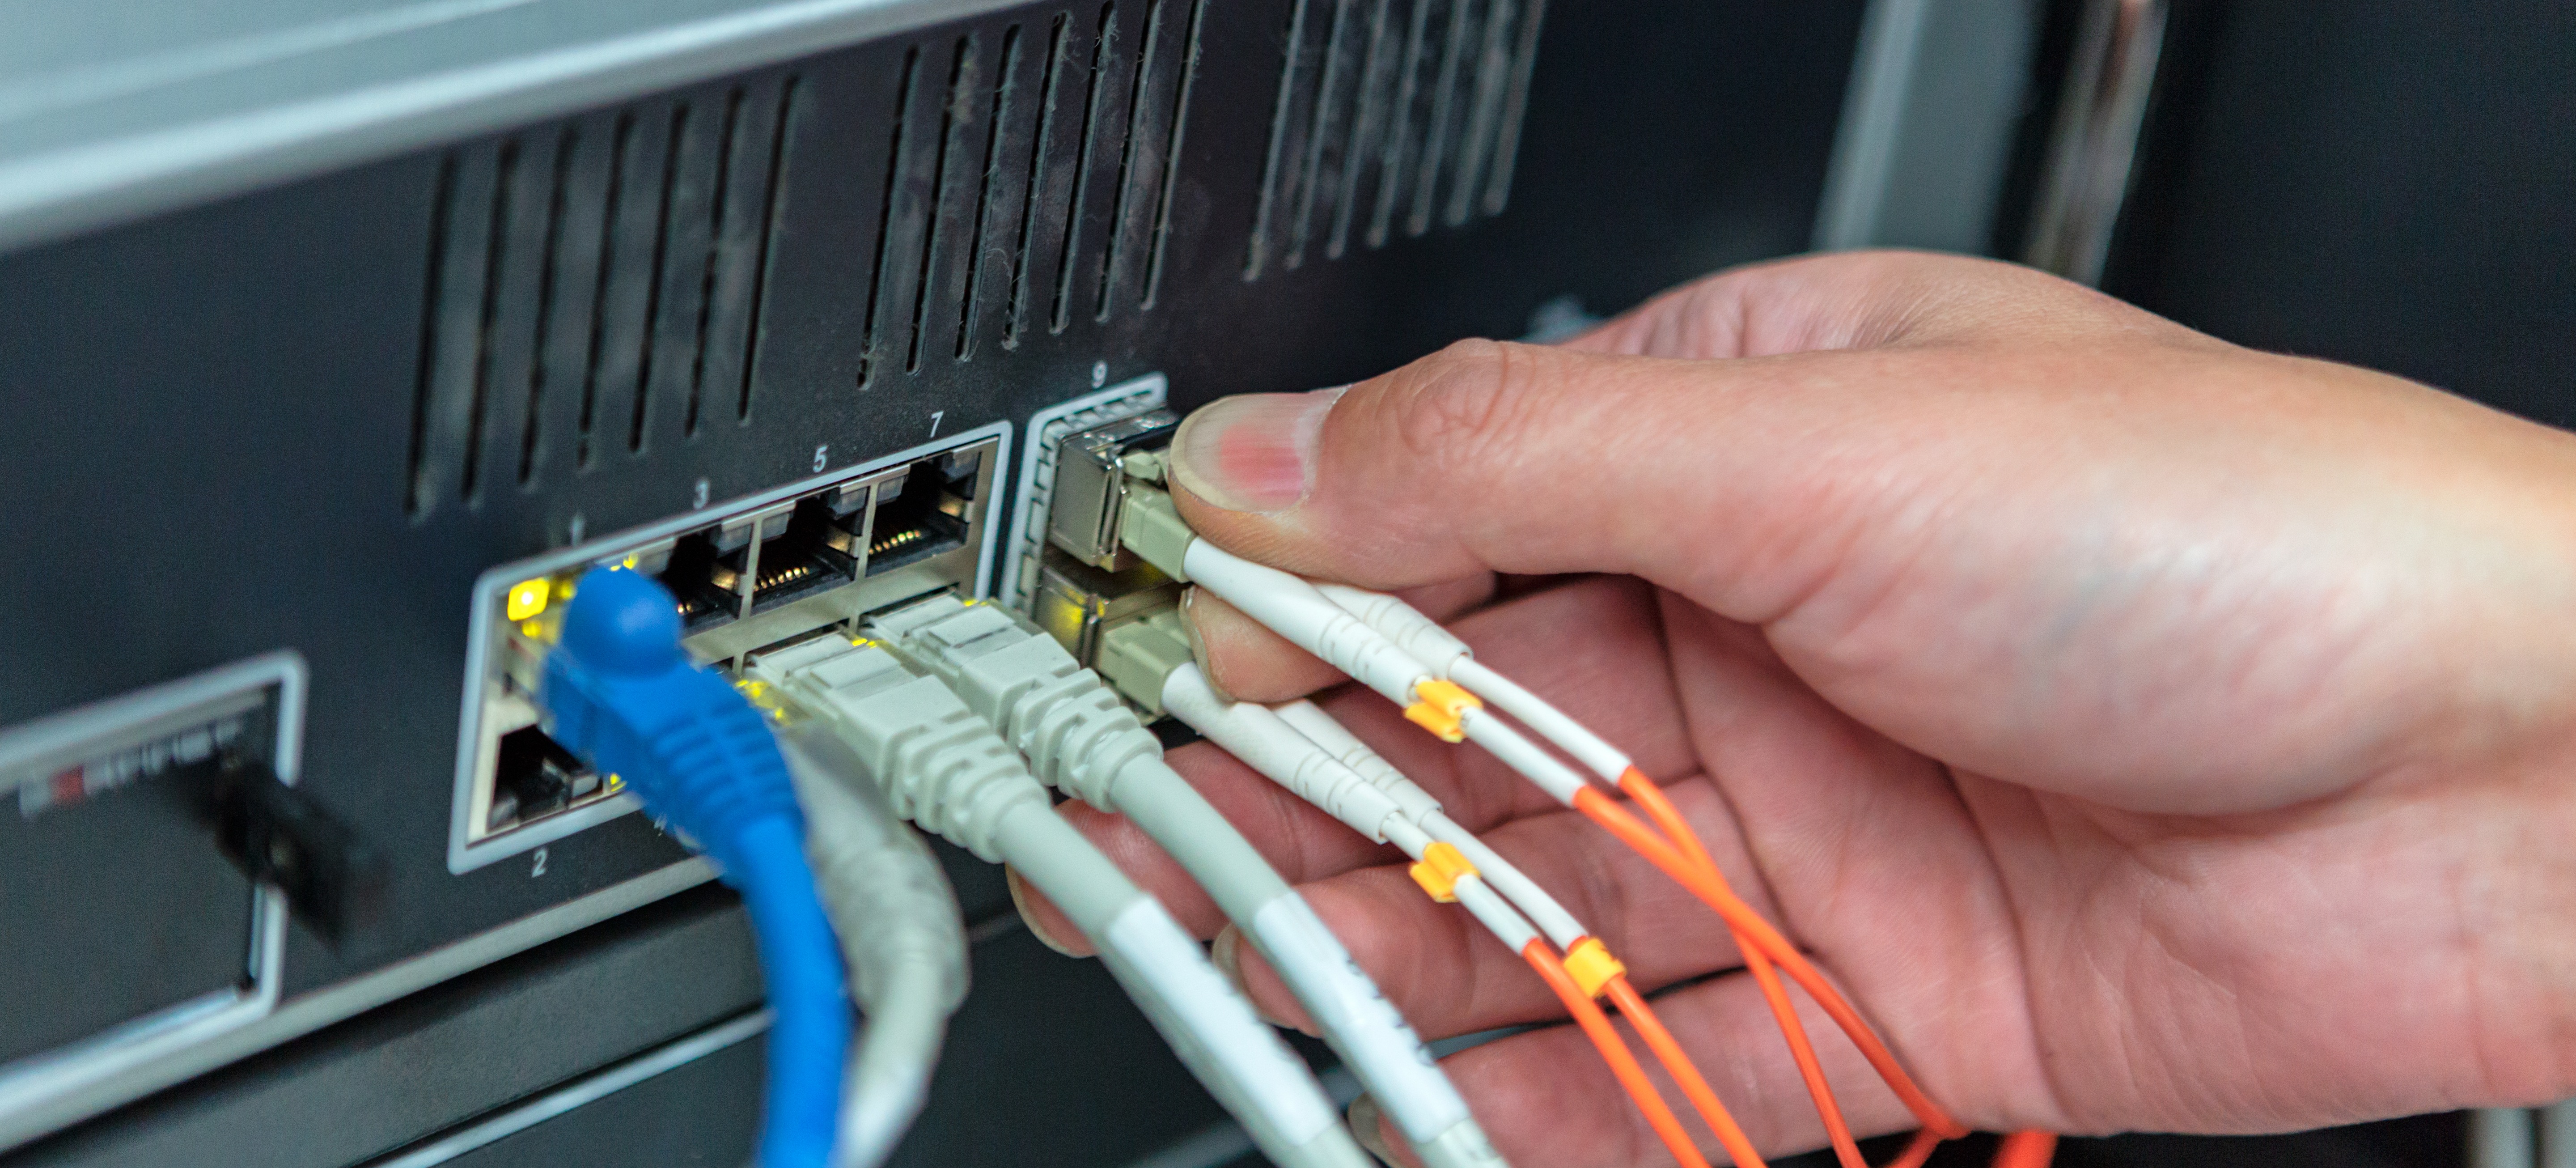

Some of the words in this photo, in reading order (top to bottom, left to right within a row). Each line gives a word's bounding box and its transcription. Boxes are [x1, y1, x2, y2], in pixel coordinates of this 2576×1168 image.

[1092, 360, 1108, 388] 9
[930, 411, 944, 437] 7
[813, 446, 828, 472] 5
[694, 479, 710, 509] 3
[532, 848, 548, 878] 2
